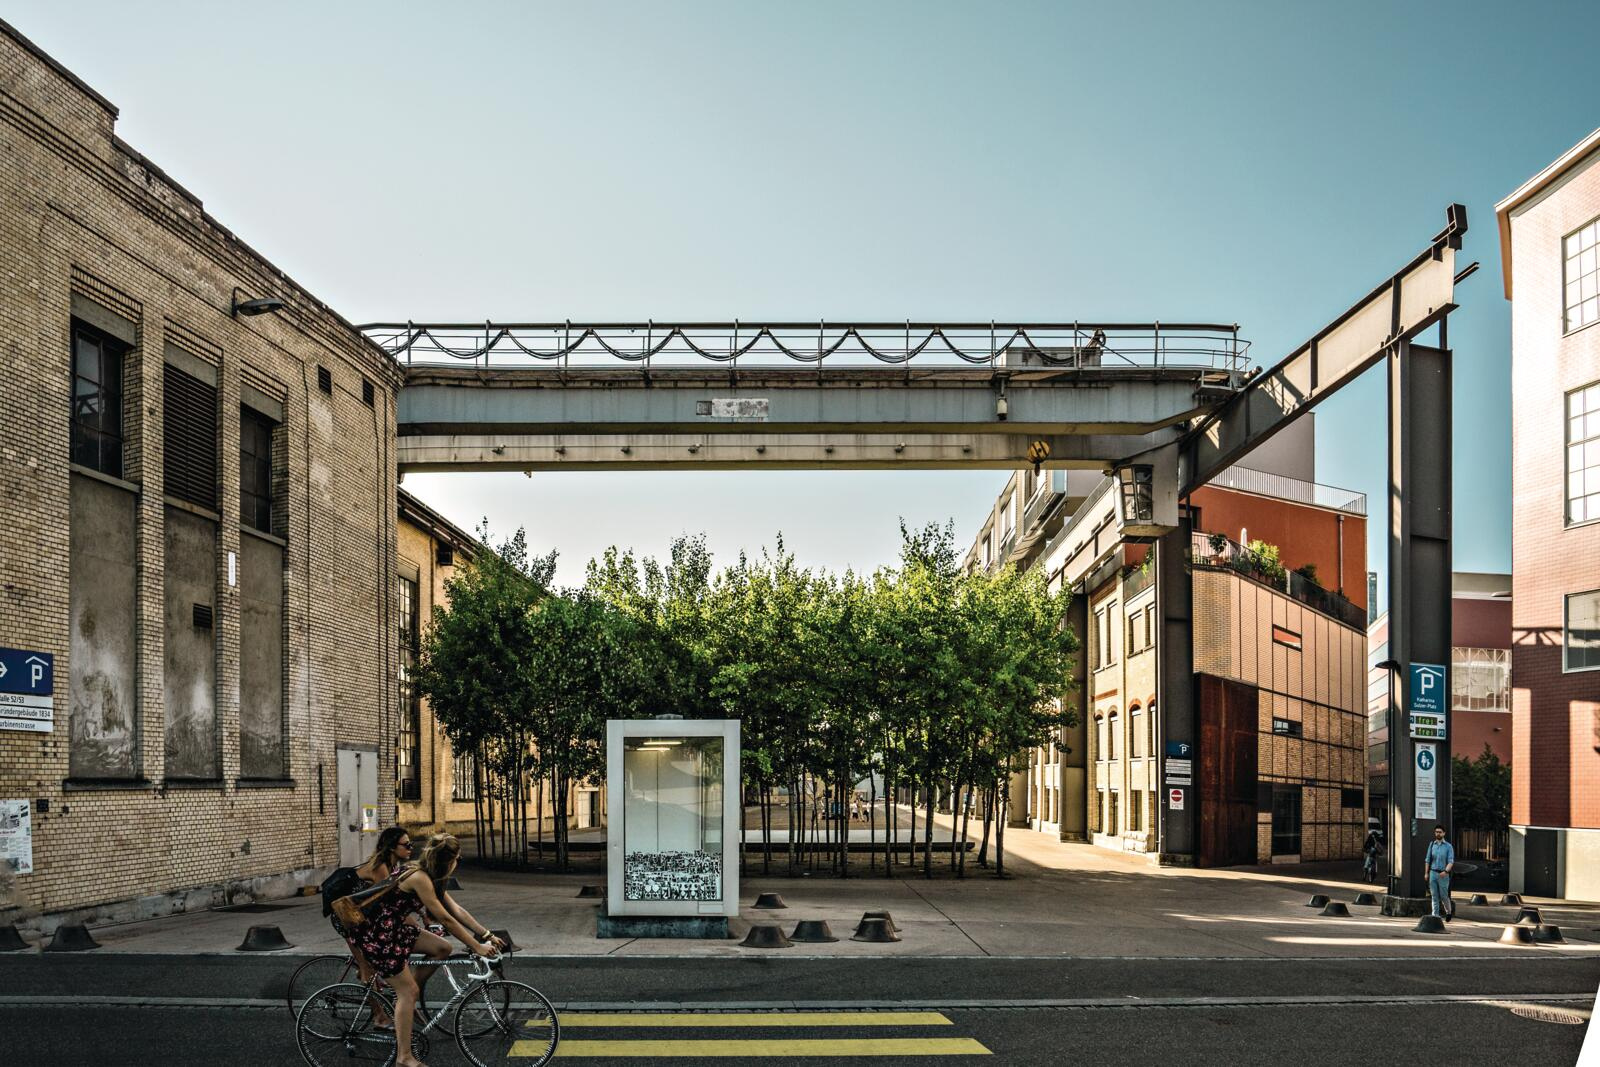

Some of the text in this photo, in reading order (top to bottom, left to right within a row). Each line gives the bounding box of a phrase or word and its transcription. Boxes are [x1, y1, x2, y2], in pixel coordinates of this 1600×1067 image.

[32, 664, 42, 688] P
[1421, 673, 1434, 695] P
[10, 695, 24, 703] 52/53
[0, 707, 38, 717] ründergebäude
[0, 720, 35, 729] urbinenstrasse
[1419, 716, 1433, 725] frei
[1181, 746, 1187, 755] P
